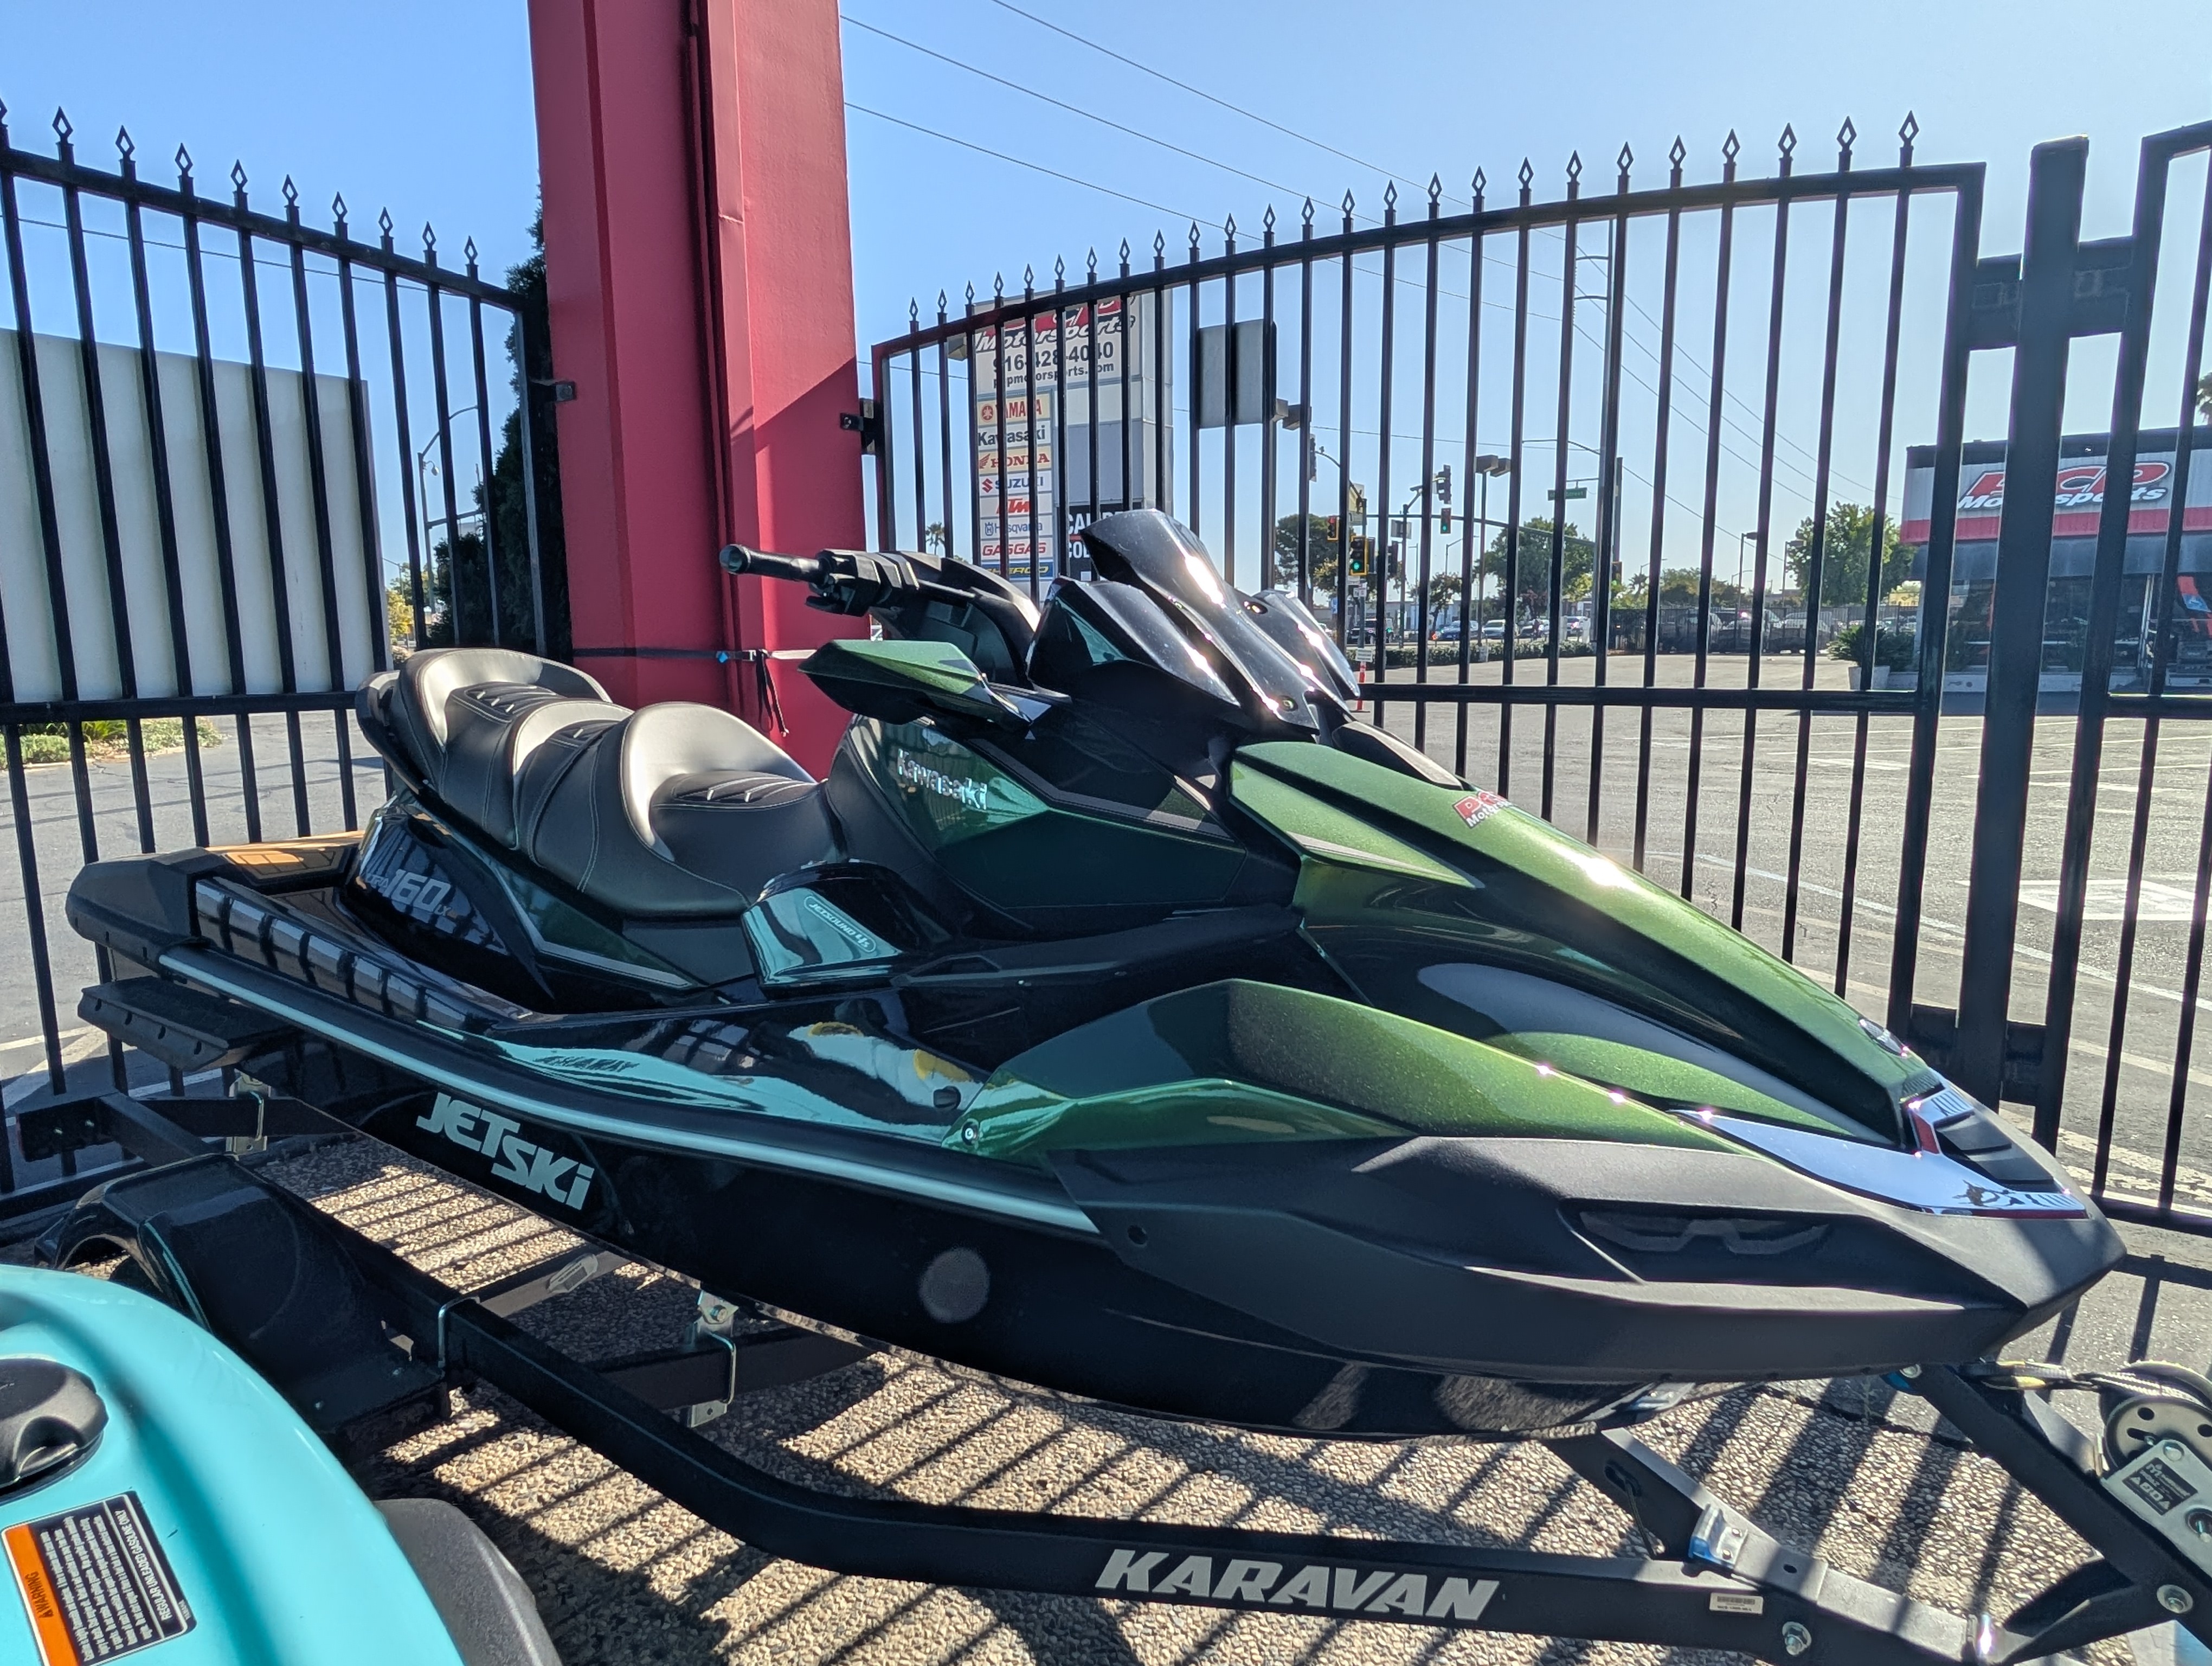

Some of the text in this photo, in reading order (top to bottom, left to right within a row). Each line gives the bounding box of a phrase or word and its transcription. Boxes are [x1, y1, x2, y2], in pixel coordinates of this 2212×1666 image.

[978, 425, 1045, 446] Kaasaki
[991, 453, 1050, 468] HONA
[995, 477, 1044, 489] SZUI
[897, 748, 987, 810] Kawasaki
[382, 869, 452, 913] 160
[809, 901, 856, 936] JETSOUND
[114, 1508, 173, 1620] REGULAR UNLEADED GASOLINE ONLY
[24, 1571, 51, 1612] WARNING
[1094, 1548, 1500, 1622] KARAVAN
